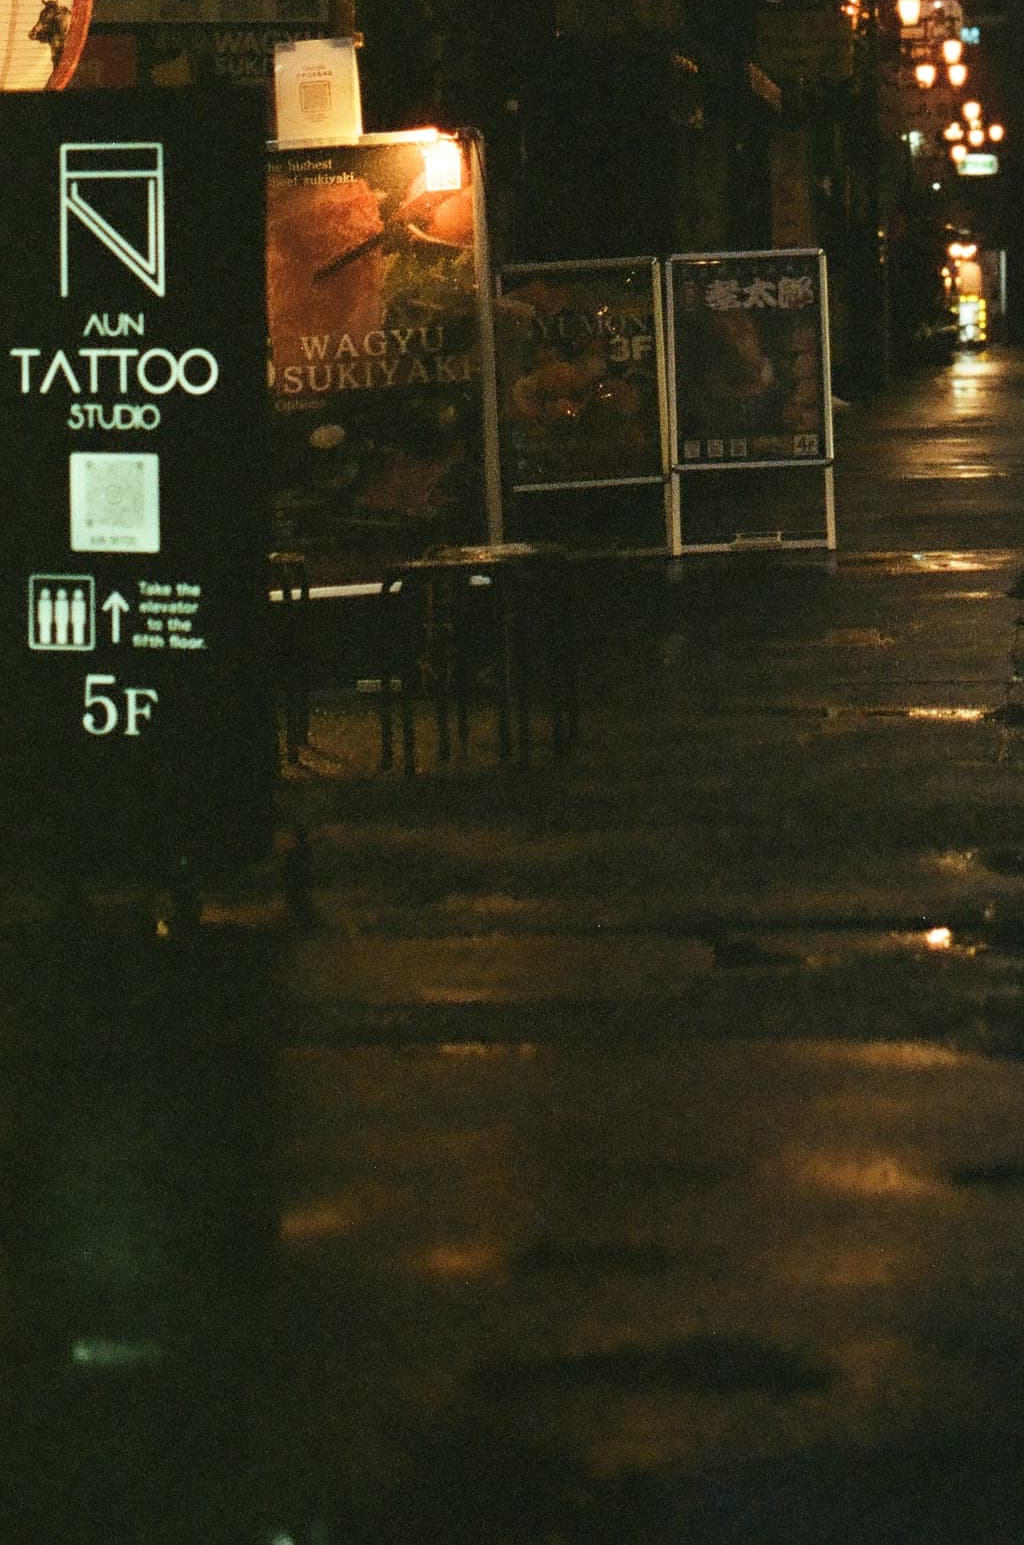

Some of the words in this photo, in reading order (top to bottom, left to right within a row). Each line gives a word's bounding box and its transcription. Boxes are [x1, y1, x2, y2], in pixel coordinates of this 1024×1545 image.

[83, 313, 144, 336] AUN
[301, 326, 445, 362] WAGYU
[609, 335, 653, 363] 3F
[10, 348, 218, 395] TATTOO
[283, 356, 473, 394] SUKIYAKI
[68, 404, 161, 430] STUDIO
[138, 581, 172, 597] Take
[176, 582, 201, 597] the
[138, 600, 199, 615] elevator
[147, 618, 163, 632] to
[167, 618, 193, 633] the
[83, 674, 158, 735] 5F
